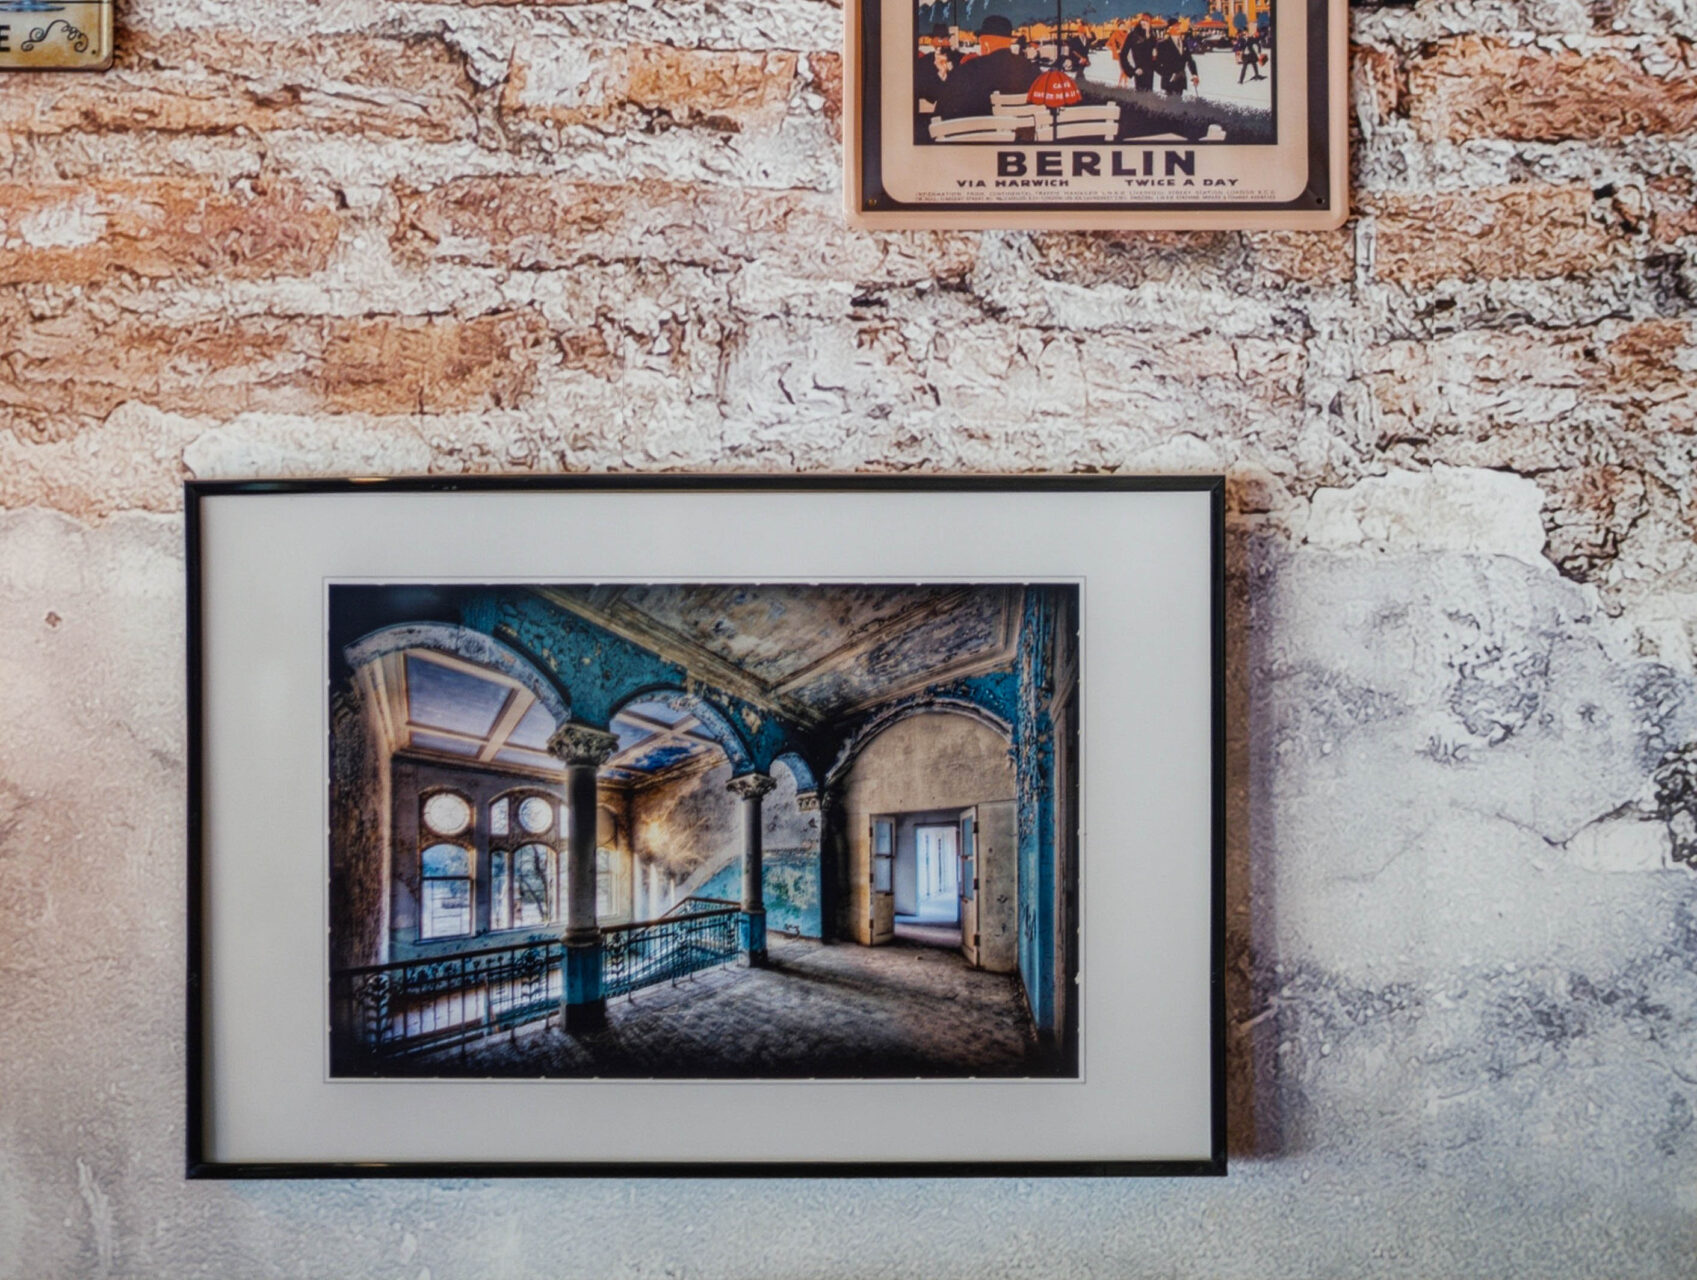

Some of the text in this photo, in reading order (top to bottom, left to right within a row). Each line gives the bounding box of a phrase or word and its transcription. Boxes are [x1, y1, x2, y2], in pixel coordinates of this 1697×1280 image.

[997, 150, 1196, 177] BERLIN
[956, 178, 1239, 188] VIA HARWICH TWICE A DAY
